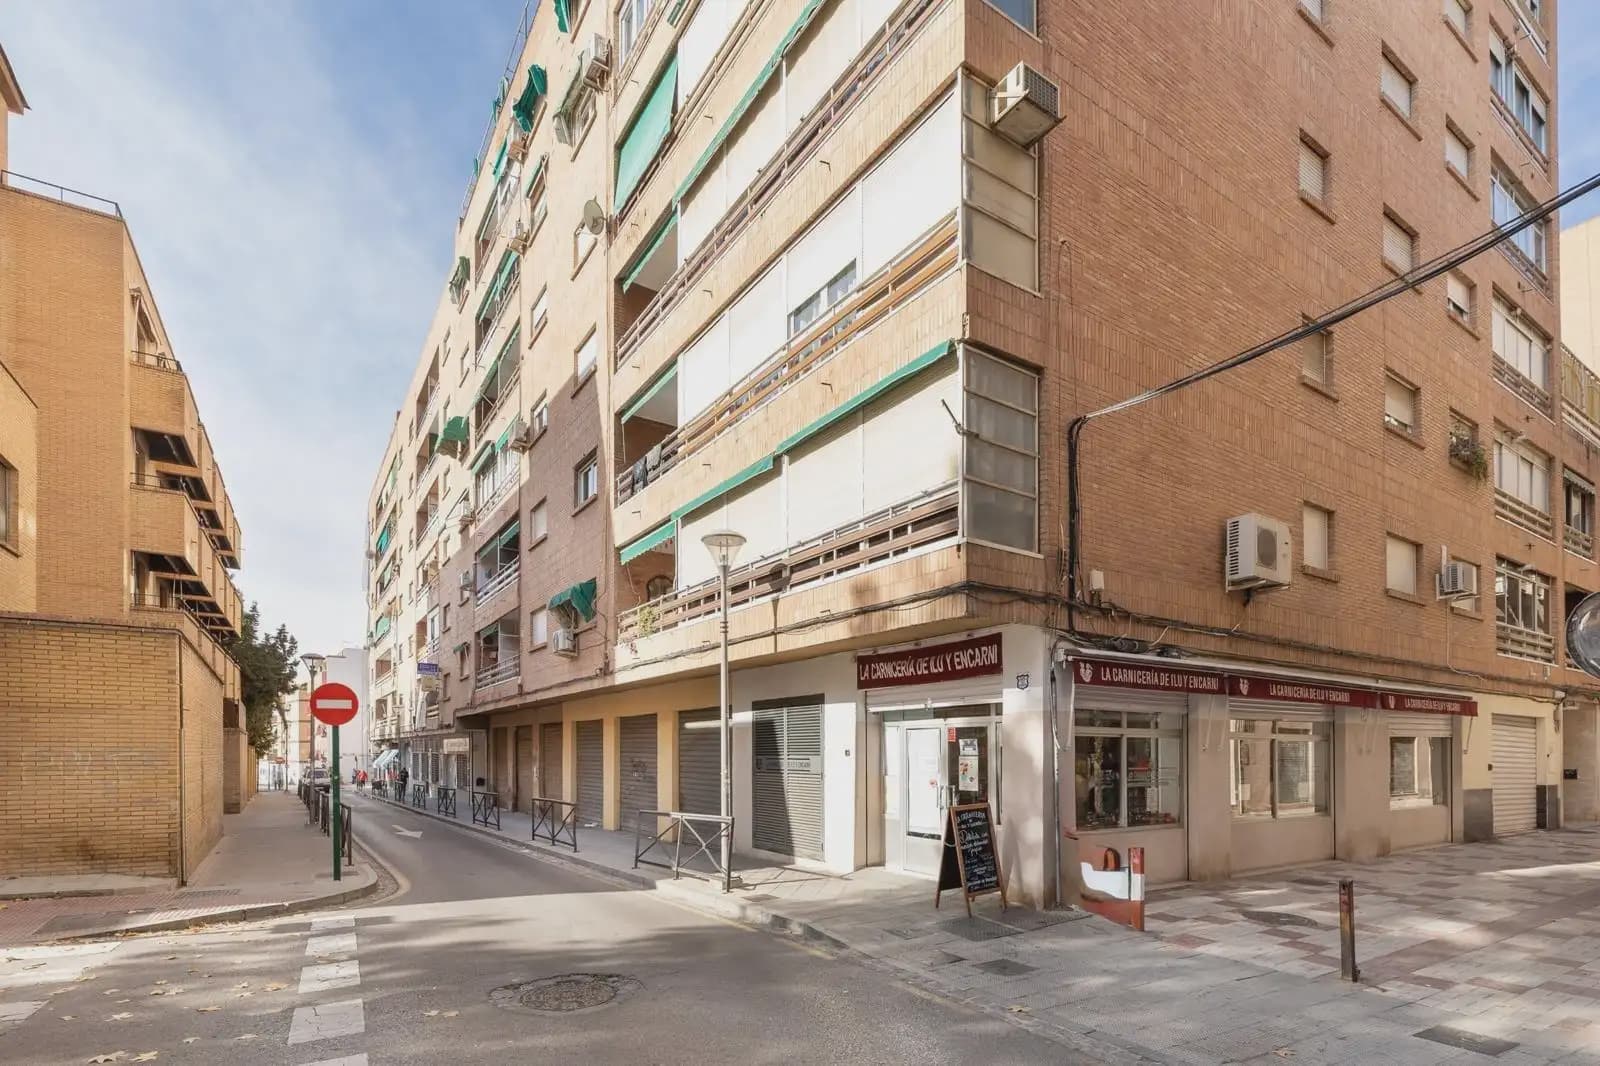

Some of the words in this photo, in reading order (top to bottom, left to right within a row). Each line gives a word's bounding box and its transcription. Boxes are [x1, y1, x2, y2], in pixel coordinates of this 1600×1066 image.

[859, 664, 870, 681] LA
[871, 655, 916, 680] CARNICERÍA
[916, 657, 929, 675] DE
[929, 654, 944, 673] ILU
[945, 652, 953, 672] Y
[953, 644, 998, 670] ENCARNI
[1101, 666, 1112, 681] LA
[1112, 668, 1159, 686] CARNICERÍA
[1160, 672, 1170, 687] DE
[1181, 675, 1188, 688] Y
[1189, 675, 1219, 690] ENCARNI
[1269, 683, 1277, 696] LA
